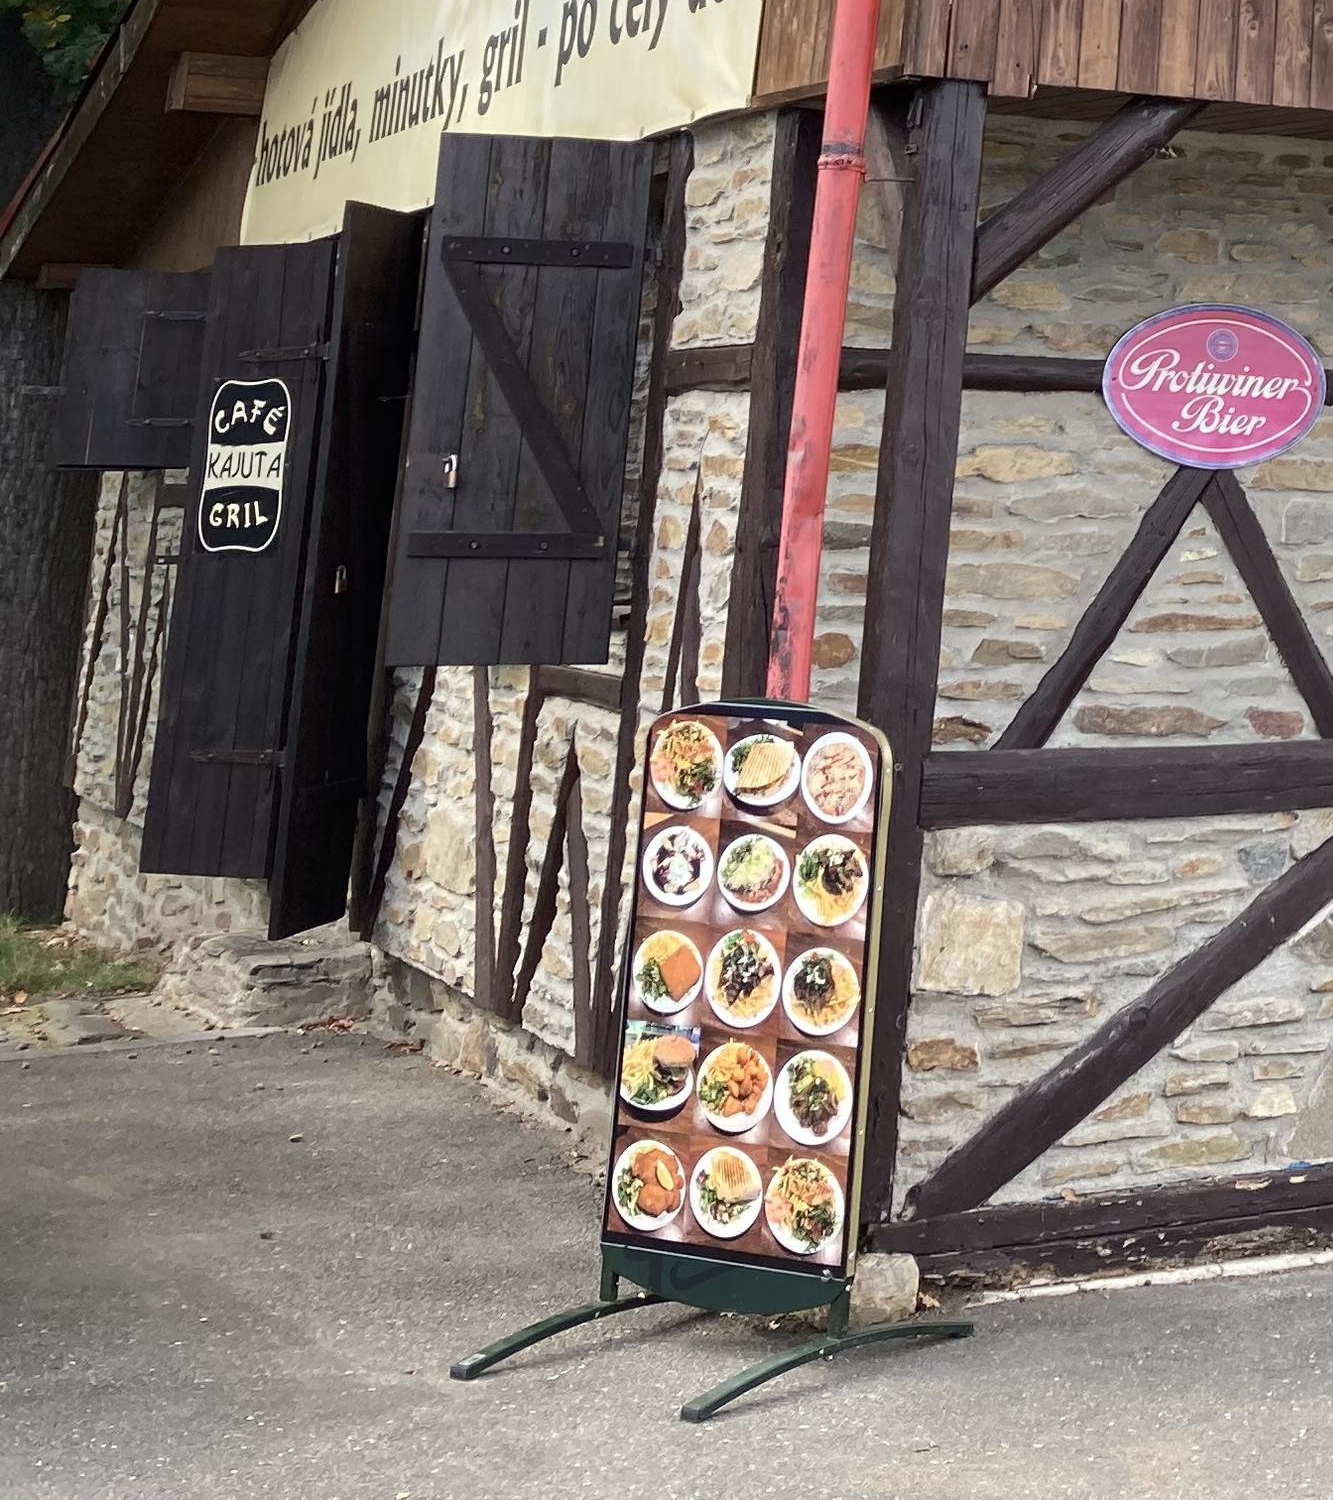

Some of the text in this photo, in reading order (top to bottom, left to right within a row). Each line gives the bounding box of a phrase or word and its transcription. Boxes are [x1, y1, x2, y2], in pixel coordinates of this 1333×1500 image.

[255, 95, 319, 188] hotová
[313, 80, 361, 181] jídla,
[368, 38, 469, 143] minutky,
[214, 399, 287, 436] CAFÉ
[1171, 394, 1267, 437] Bier
[207, 450, 283, 480] KAJUTA
[209, 500, 269, 529] GRIL
